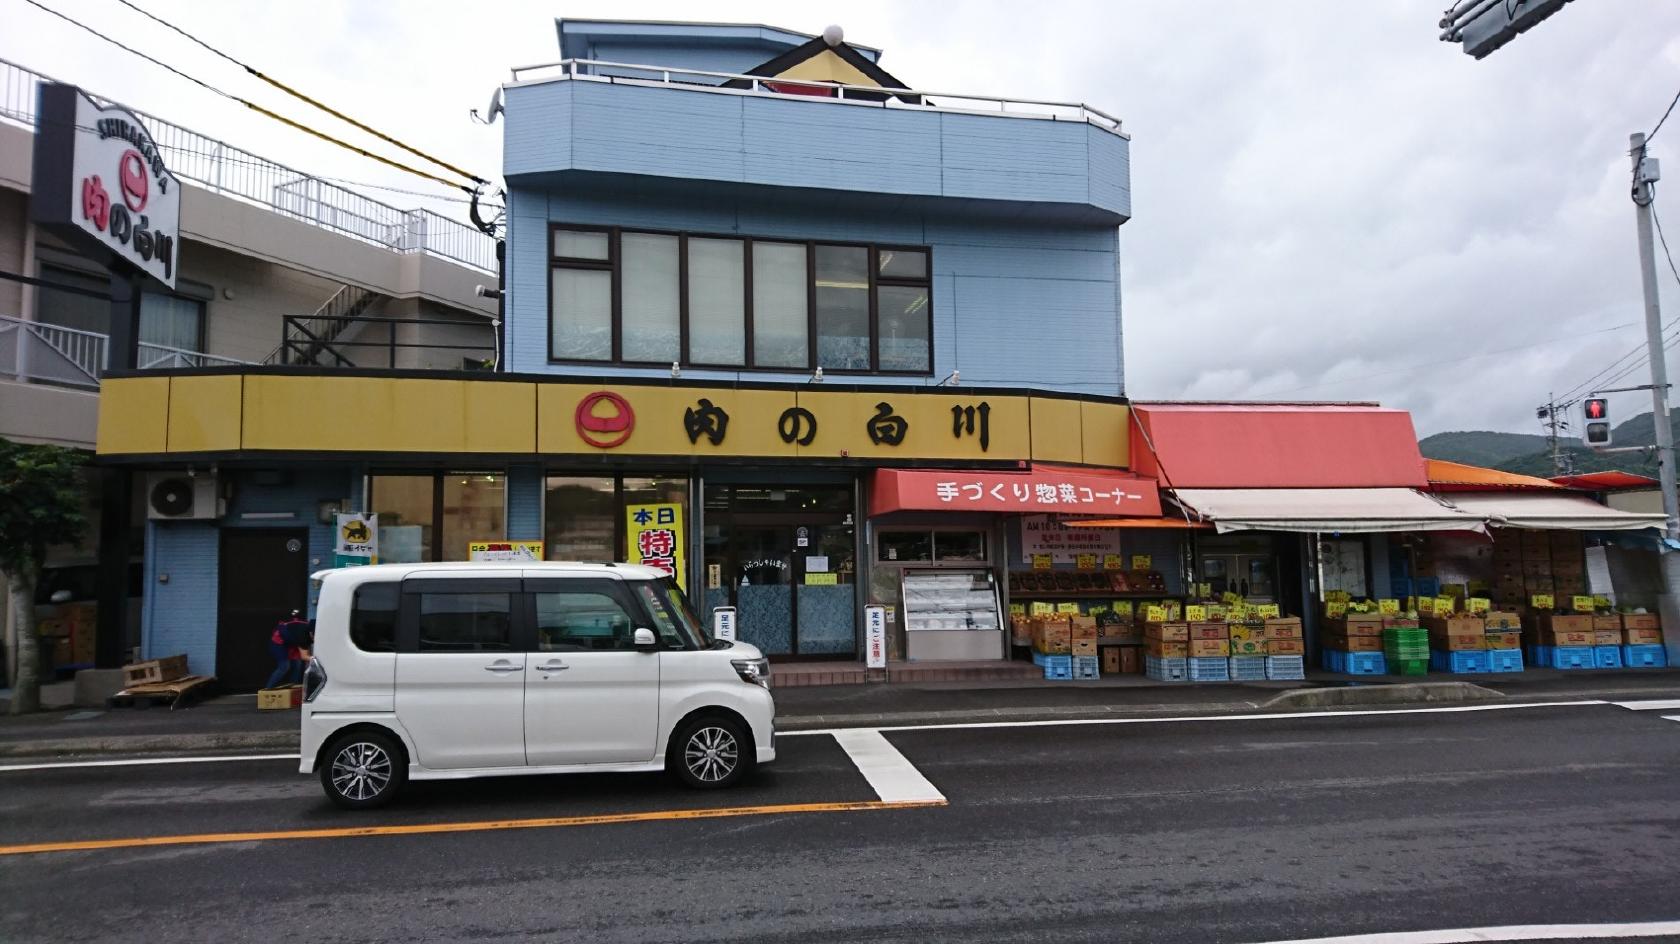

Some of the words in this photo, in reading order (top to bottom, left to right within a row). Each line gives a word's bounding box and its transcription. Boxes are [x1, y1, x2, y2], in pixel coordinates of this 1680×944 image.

[82, 174, 173, 280] 肉の白川
[683, 398, 992, 453] 肉の白川
[936, 481, 1143, 506] 手づくり惣菜コーナー
[633, 507, 675, 526] 本日
[720, 614, 730, 637] 足元に
